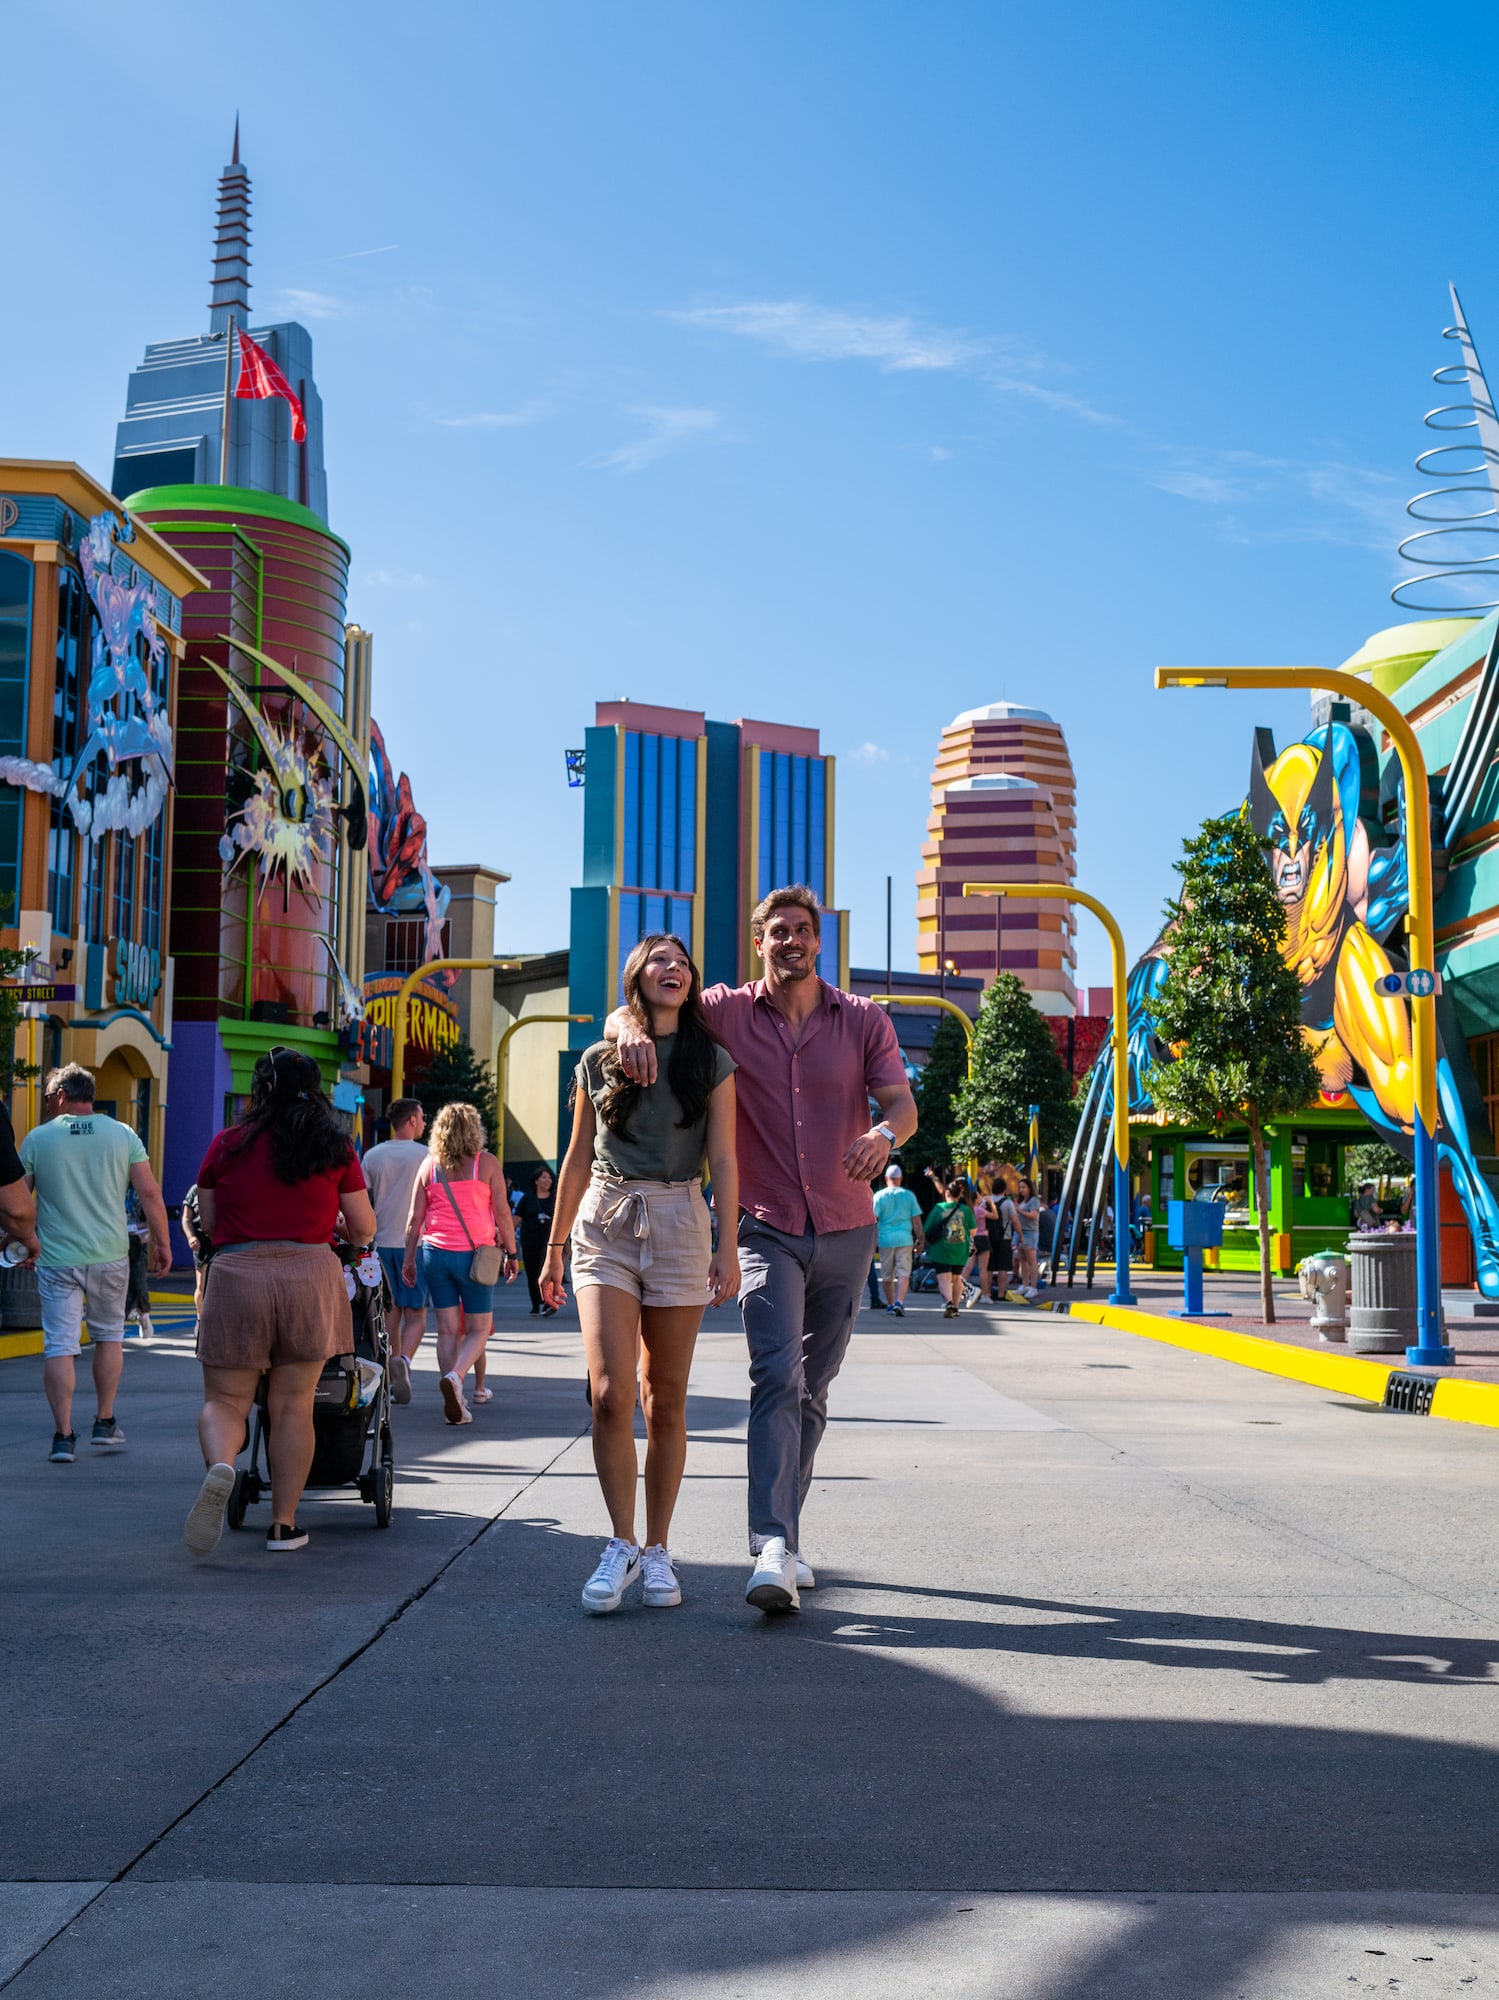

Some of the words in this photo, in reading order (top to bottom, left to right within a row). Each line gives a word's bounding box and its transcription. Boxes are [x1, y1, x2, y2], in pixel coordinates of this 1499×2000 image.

[27, 987, 55, 1000] STREET
[115, 938, 161, 1010] SHOP
[364, 996, 460, 1062] SPIER-MAN
